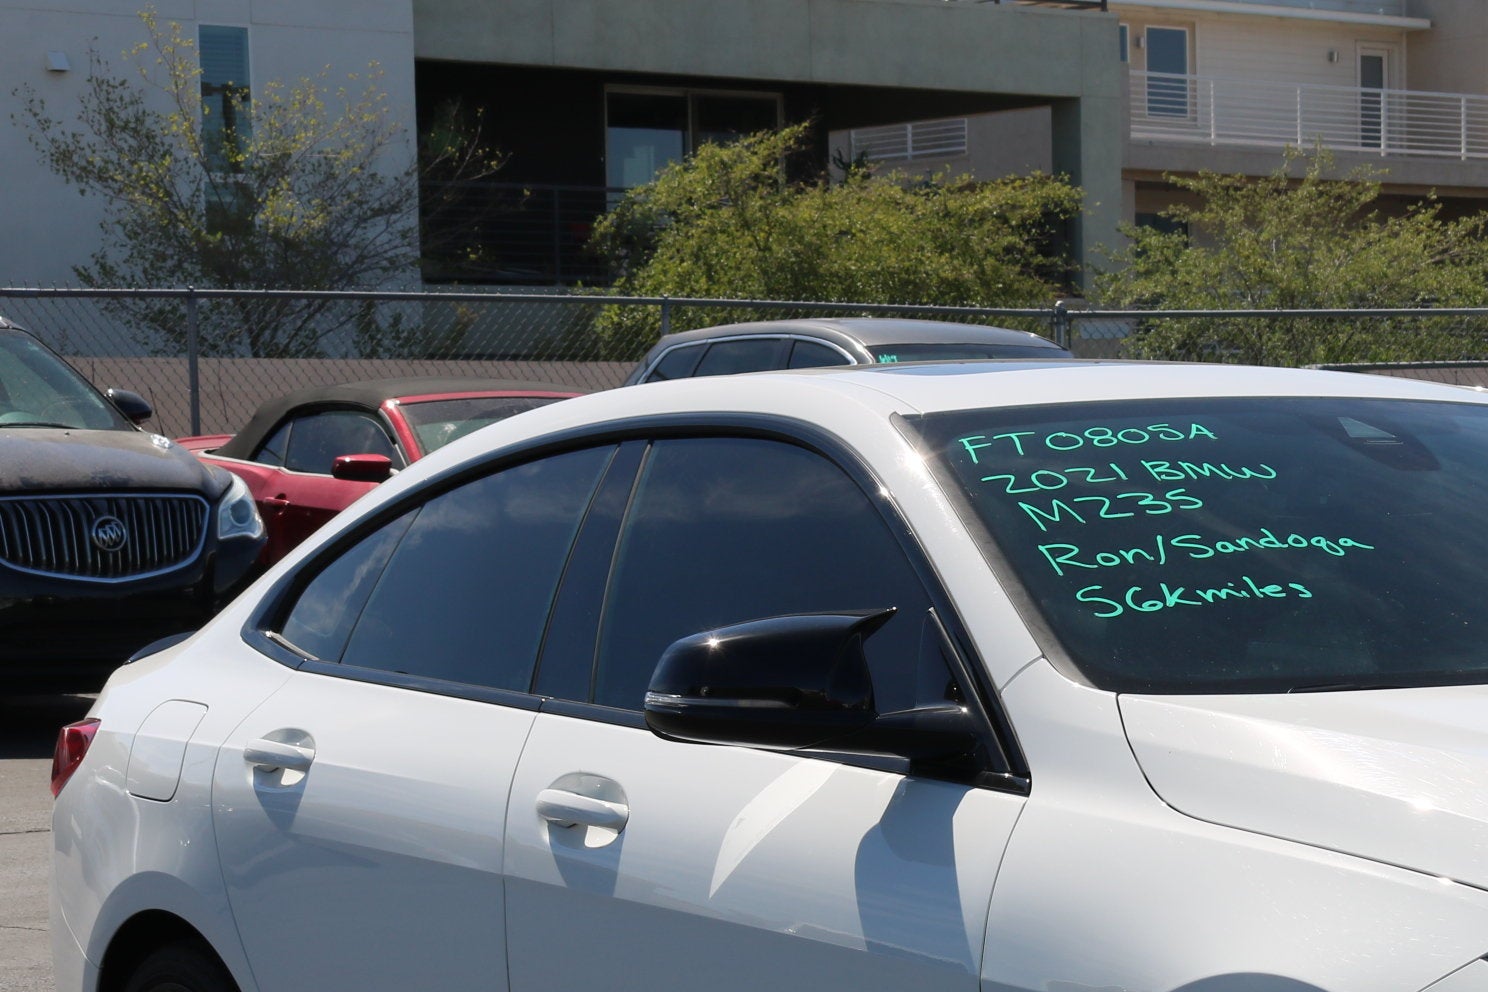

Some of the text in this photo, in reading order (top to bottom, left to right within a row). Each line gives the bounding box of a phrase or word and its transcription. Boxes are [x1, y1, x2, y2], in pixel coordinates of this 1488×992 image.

[980, 459, 1277, 494] 2021 BMW
[1017, 488, 1204, 532] M235
